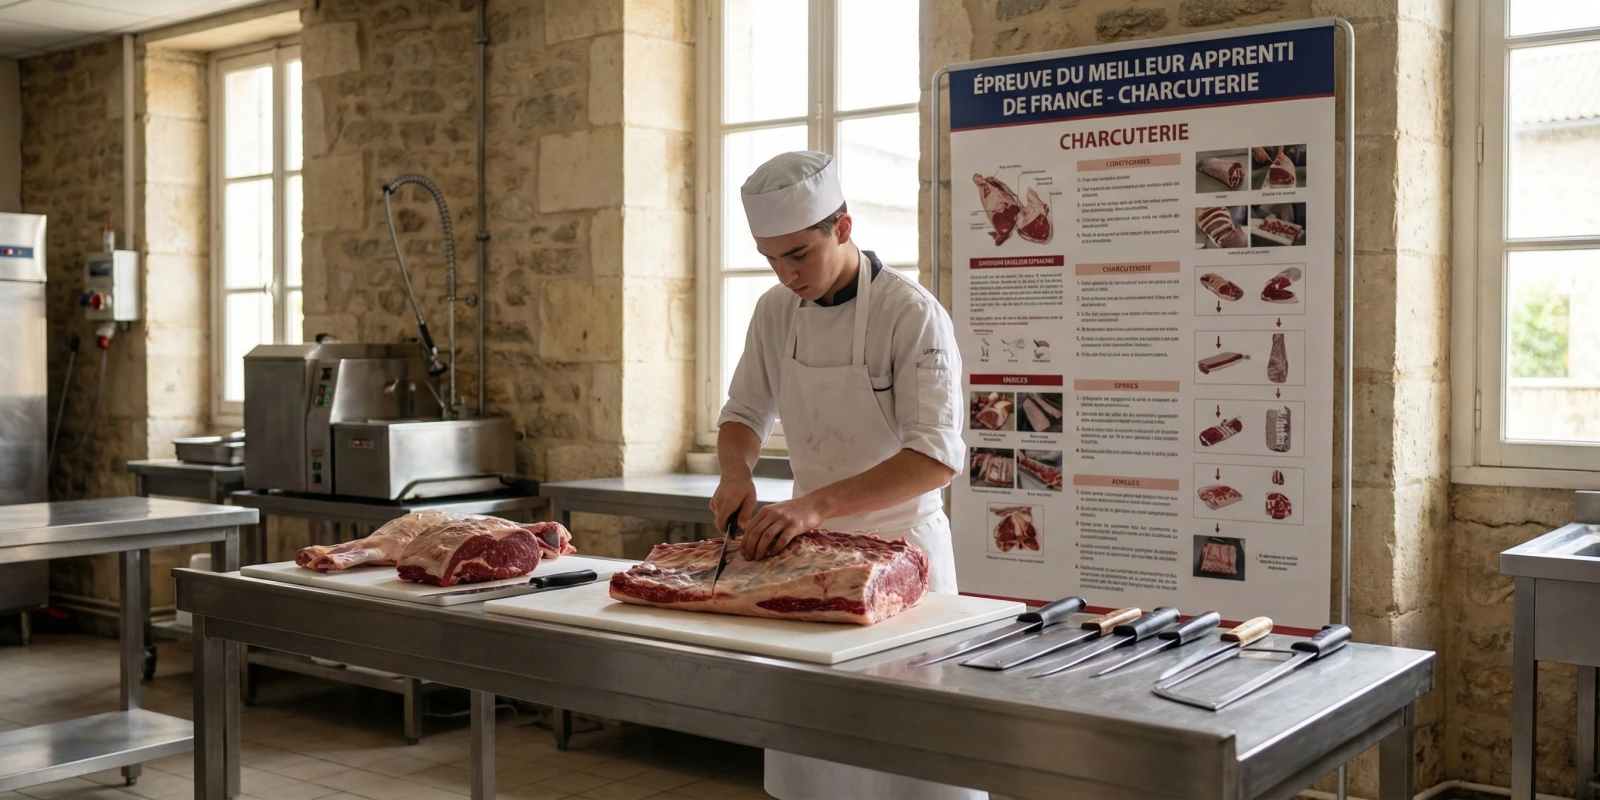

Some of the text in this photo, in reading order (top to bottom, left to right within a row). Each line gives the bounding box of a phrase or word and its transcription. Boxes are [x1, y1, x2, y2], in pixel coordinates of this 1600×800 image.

[973, 42, 1294, 95] ÉPREUVE DU MEILLEUR APPRENTI
[1003, 97, 1026, 116] DE
[1031, 88, 1103, 113] FRANCE
[1118, 73, 1259, 105] CHARCUTERIE
[1059, 122, 1190, 151] CHARCUTERIE
